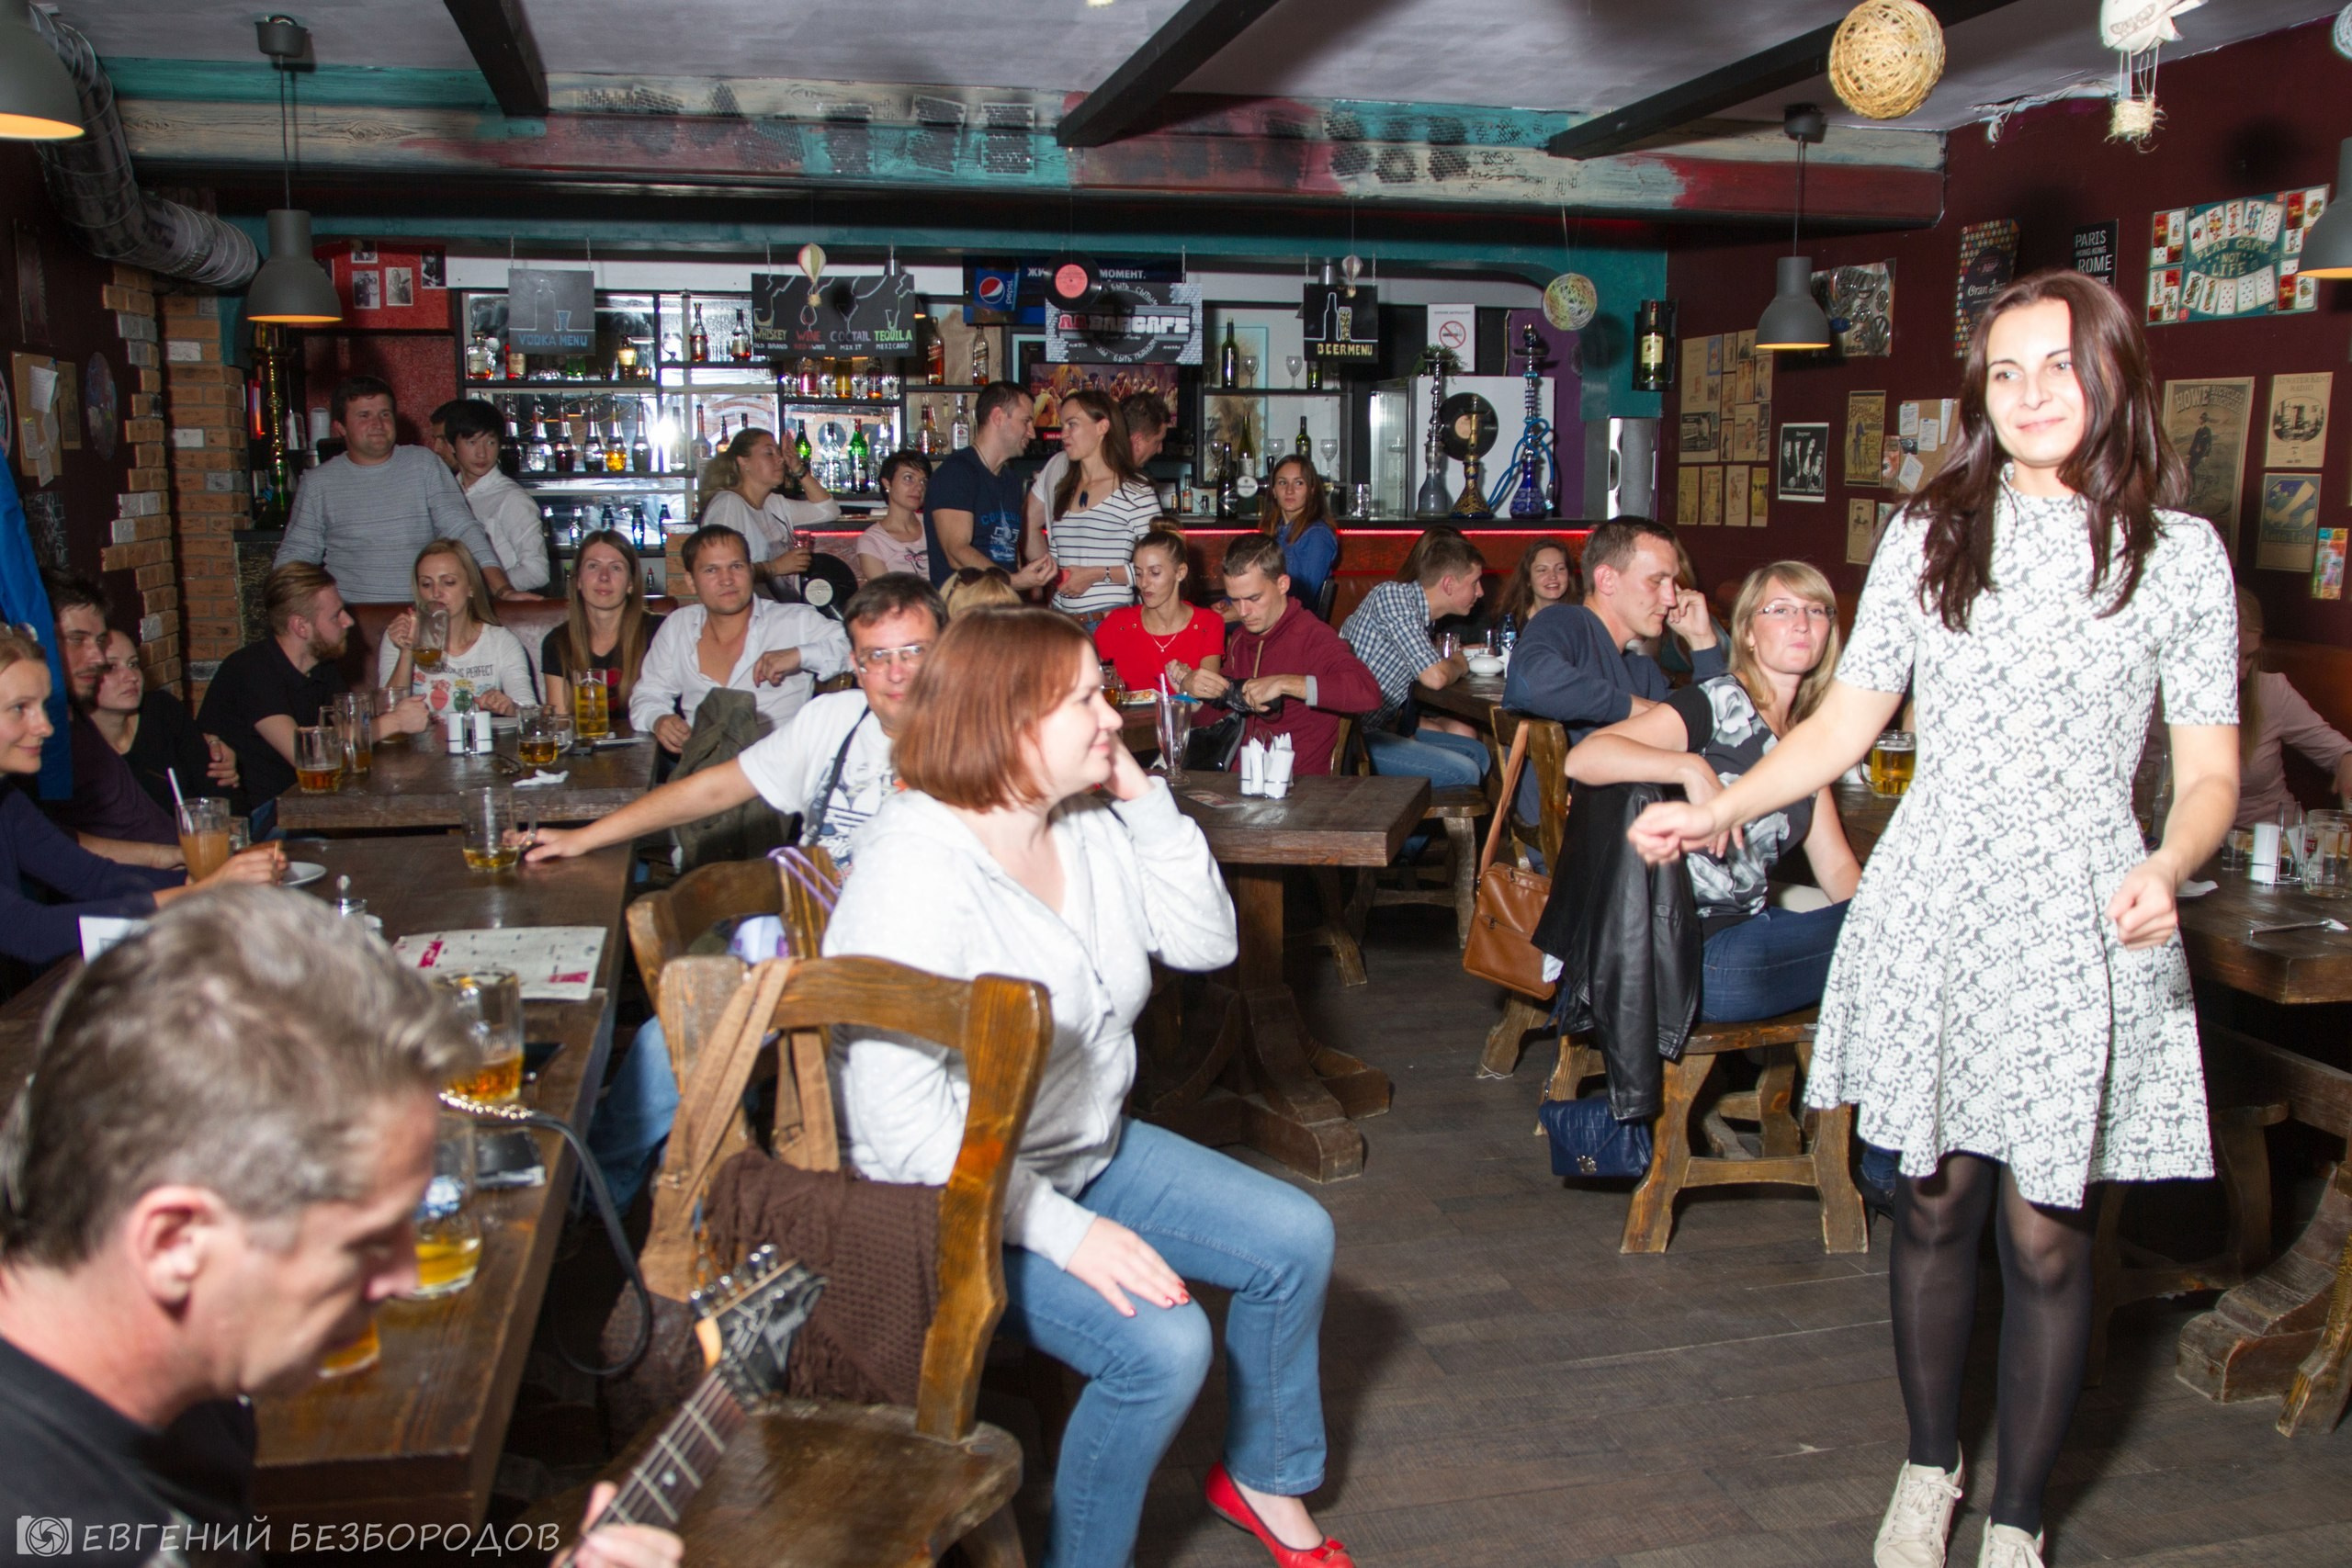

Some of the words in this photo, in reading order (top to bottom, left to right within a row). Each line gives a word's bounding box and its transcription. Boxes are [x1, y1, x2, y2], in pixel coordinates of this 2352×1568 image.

[2075, 230, 2107, 248] PARIS
[2076, 248, 2091, 257] HONG
[2092, 245, 2107, 255] KONG
[2197, 240, 2229, 260] PLAY
[2236, 239, 2272, 253] GAME
[2078, 254, 2113, 273] ROME
[2222, 253, 2242, 264] NOT
[2211, 263, 2246, 276] LIFE
[1005, 279, 1013, 304] pepsi
[518, 334, 556, 346] VODKA
[560, 335, 588, 347] MENU
[753, 329, 787, 341] WHISKEY
[796, 330, 821, 342] WINE
[830, 331, 871, 342] COCTAIL
[875, 329, 912, 342] TEQUILA
[2176, 385, 2211, 412] HOWE
[2211, 385, 2245, 403] BICYCLES
[466, 664, 493, 678] PERFECT
